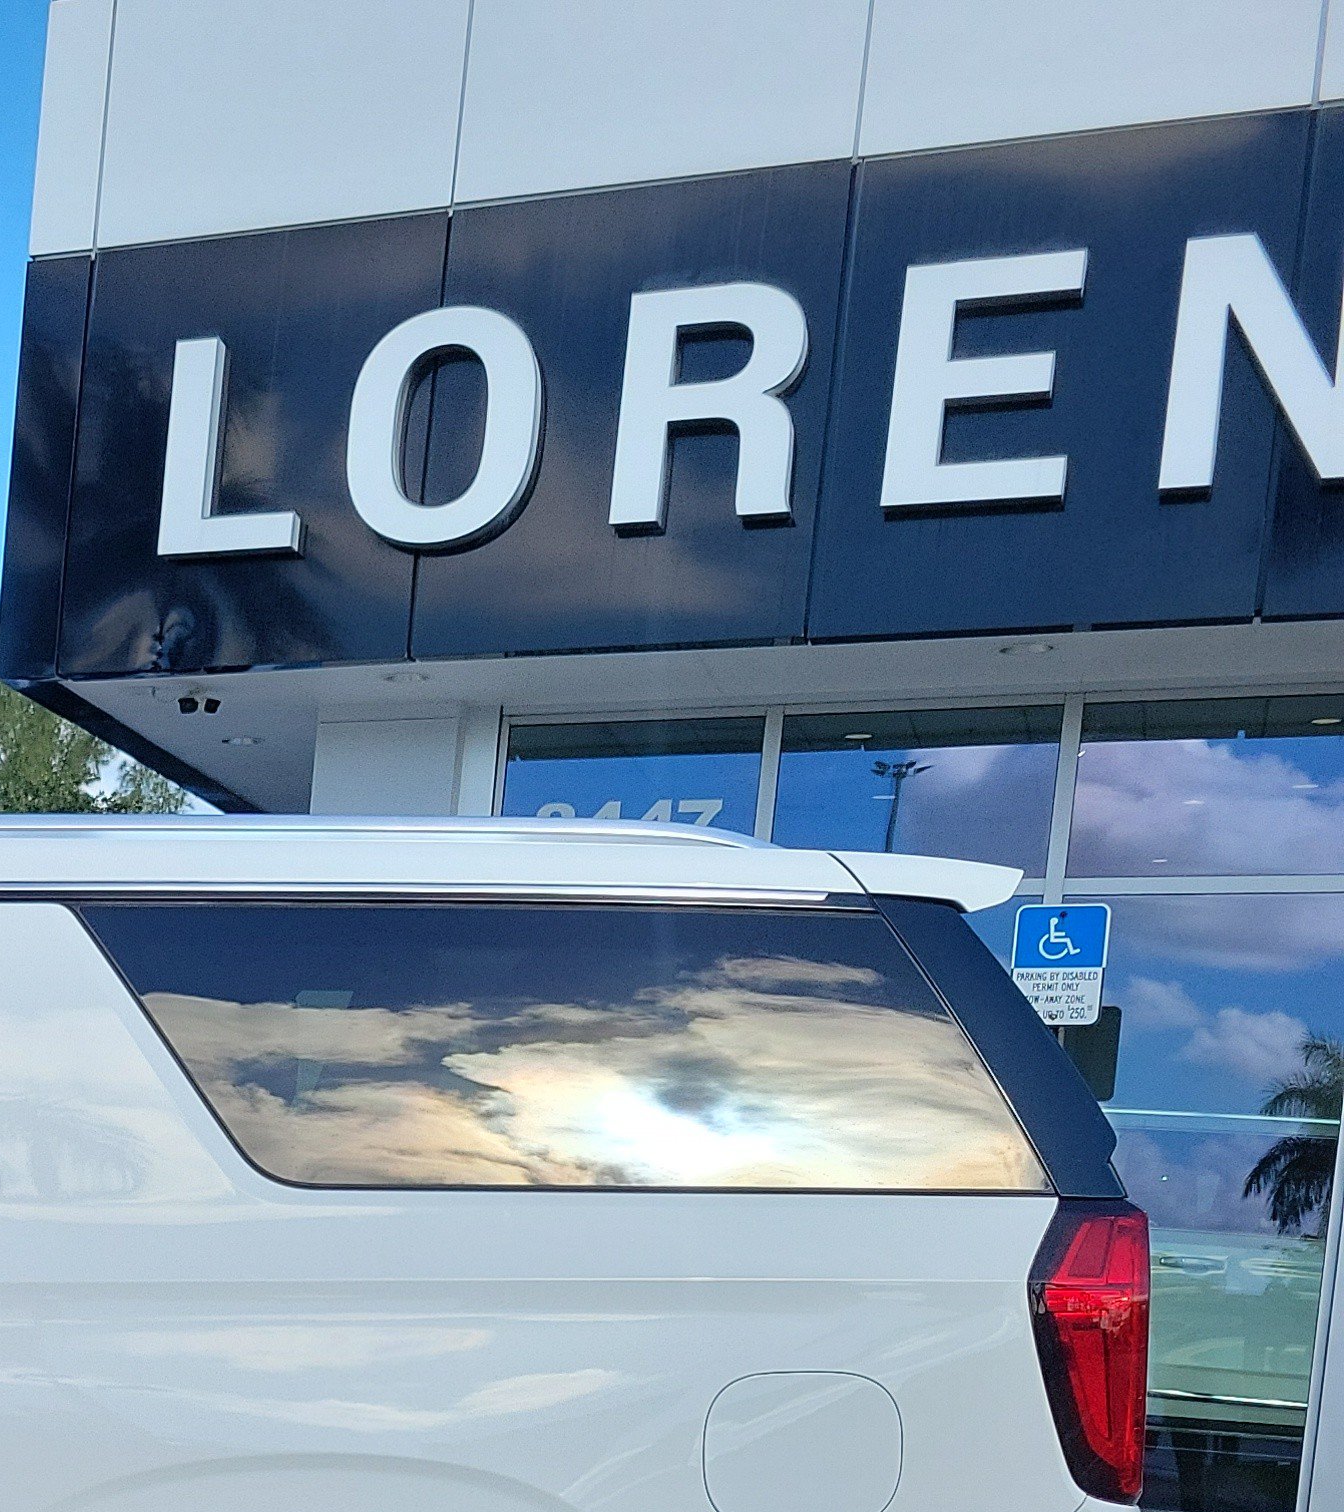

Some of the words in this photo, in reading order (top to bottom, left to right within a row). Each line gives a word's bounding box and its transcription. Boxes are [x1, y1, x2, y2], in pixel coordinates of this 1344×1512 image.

[1016, 971, 1047, 981] PARKING
[1049, 971, 1060, 981] BY
[1062, 971, 1099, 981] DISABLED
[1032, 982, 1059, 992] PERMIT
[1061, 982, 1080, 992] ONLY
[1064, 994, 1086, 1005] ZONE
